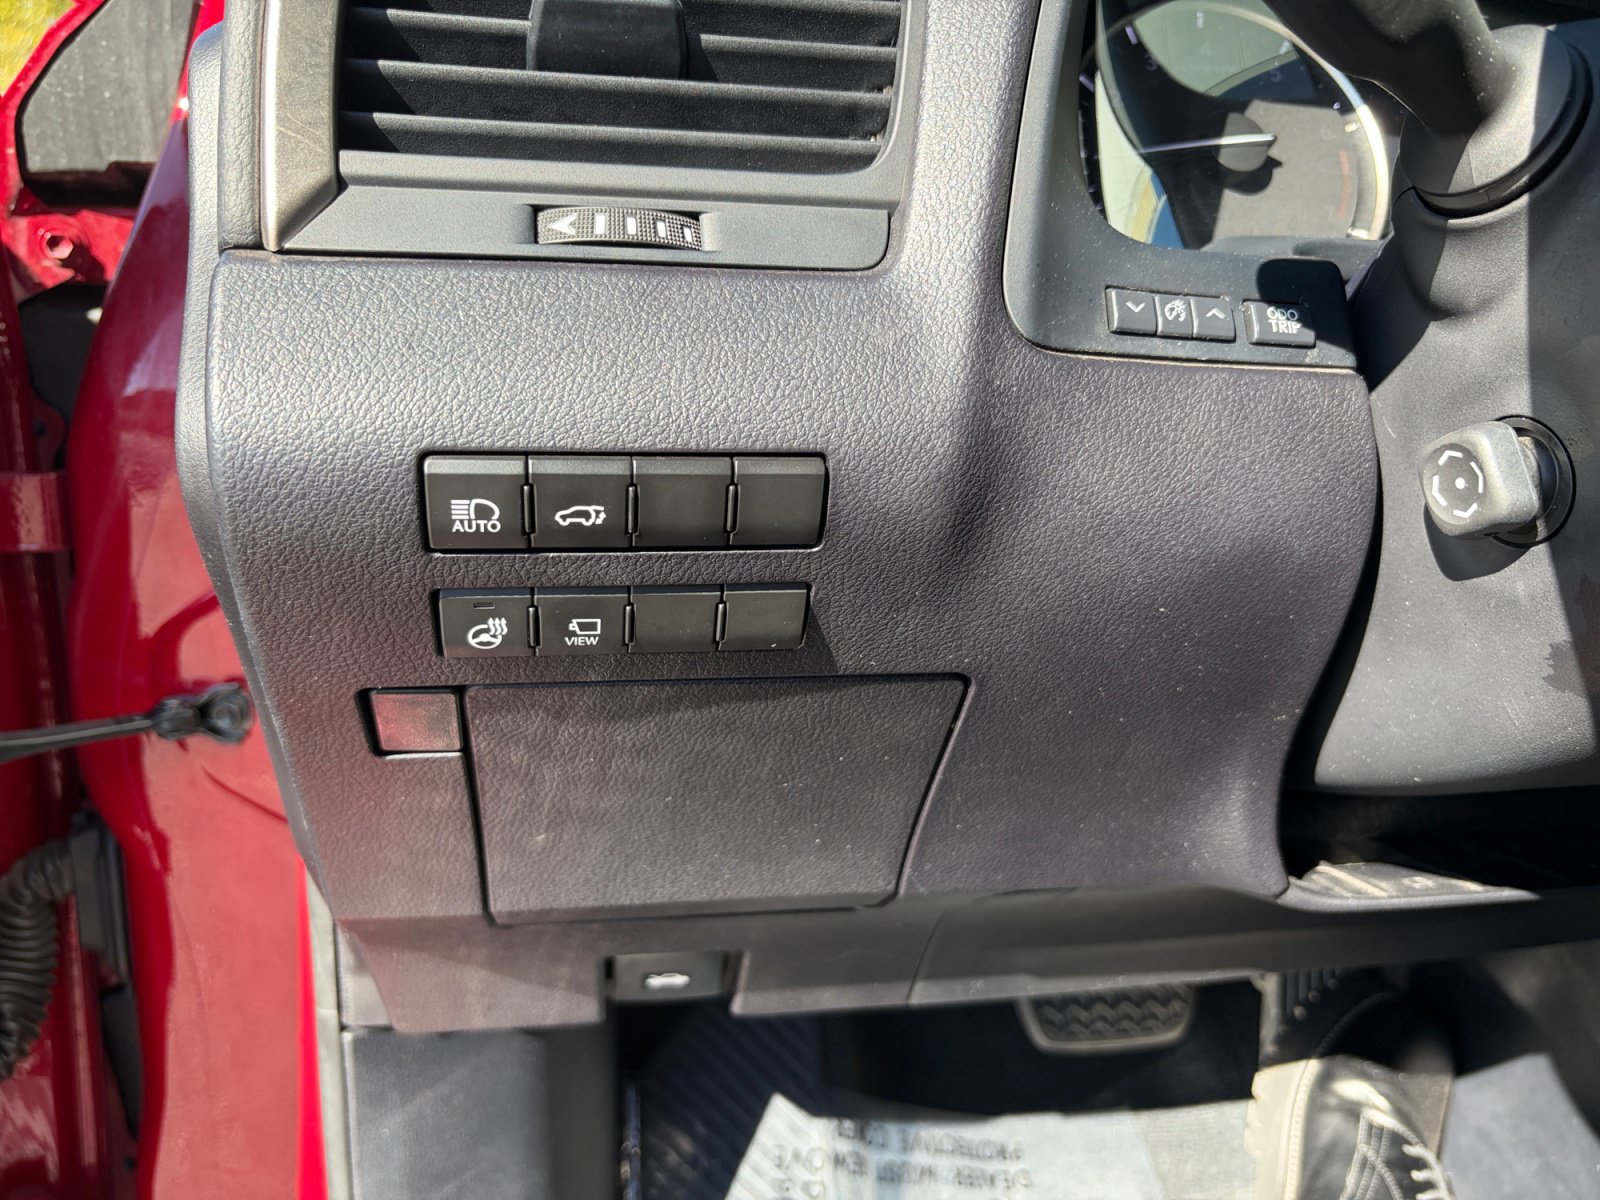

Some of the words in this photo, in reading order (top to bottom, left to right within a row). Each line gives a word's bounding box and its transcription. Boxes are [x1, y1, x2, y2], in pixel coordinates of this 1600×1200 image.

[1266, 306, 1298, 321] ODO
[1268, 319, 1301, 334] TRIP
[452, 520, 501, 533] AUTO
[565, 636, 599, 646] VIEW
